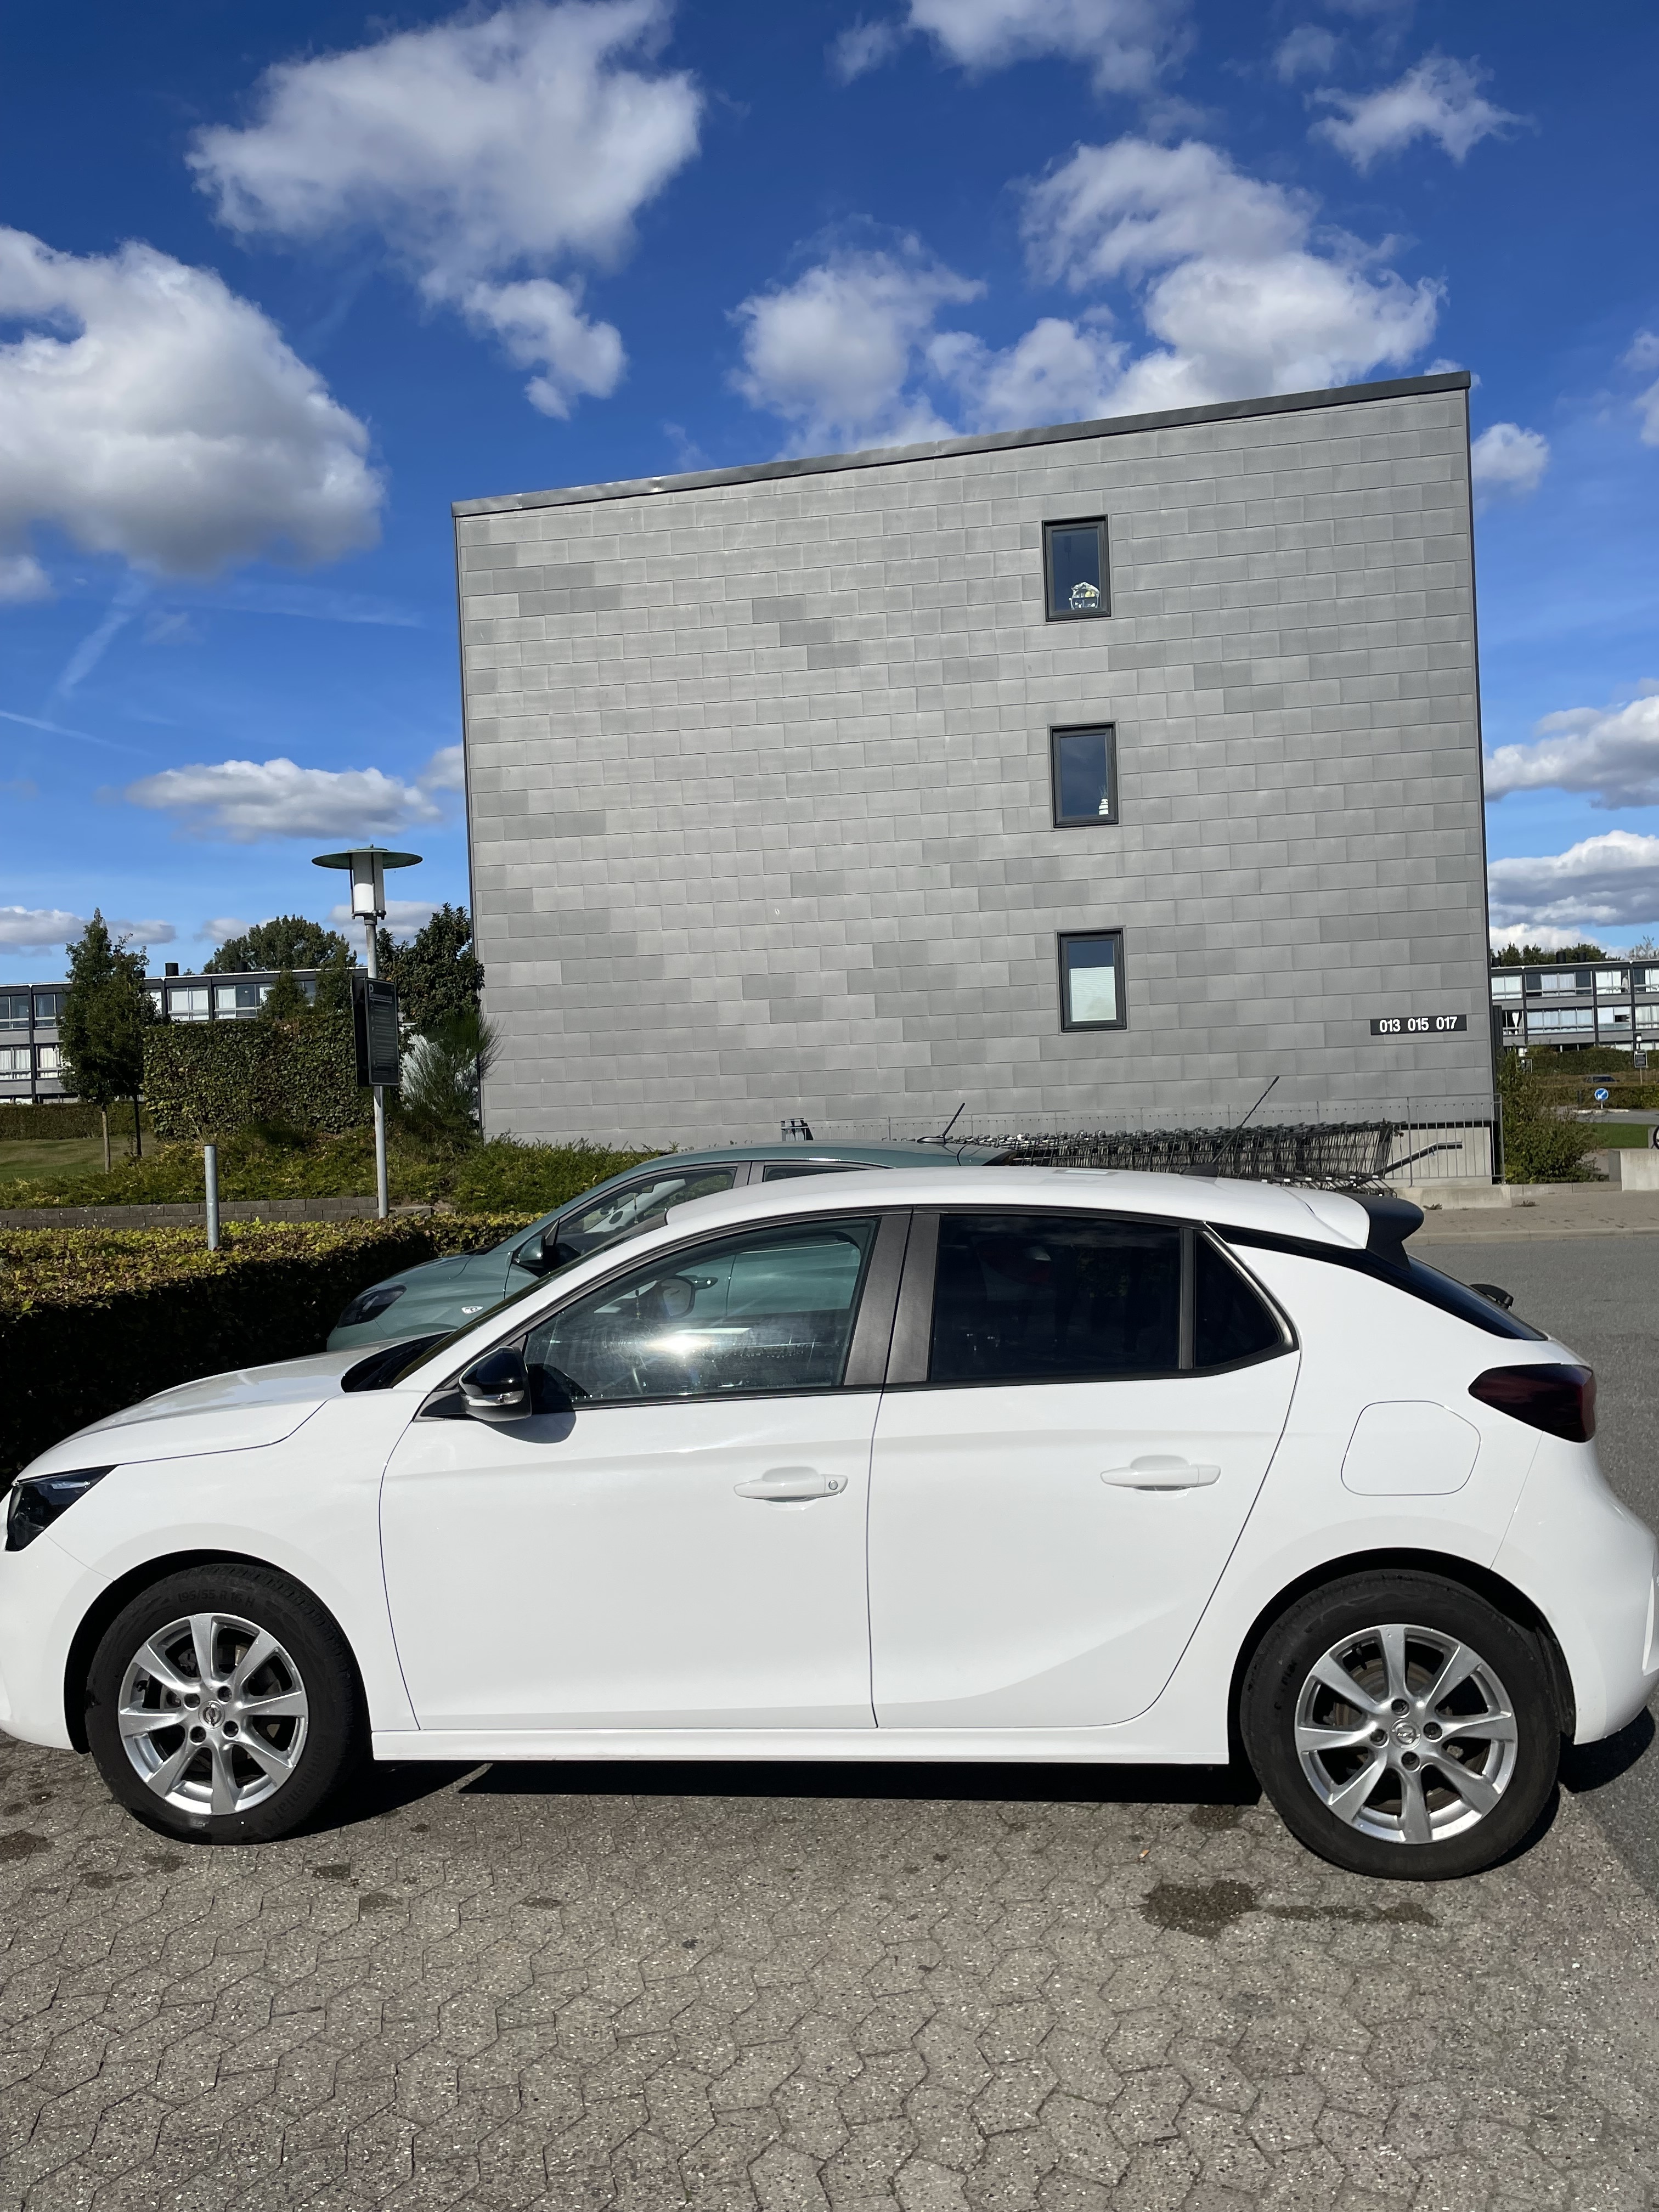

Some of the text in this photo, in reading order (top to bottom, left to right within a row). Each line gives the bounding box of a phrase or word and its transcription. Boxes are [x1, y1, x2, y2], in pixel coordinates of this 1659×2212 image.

[369, 984, 374, 997] P
[1379, 1016, 1458, 1032] 013 015 017
[178, 1589, 216, 1603] 195/55
